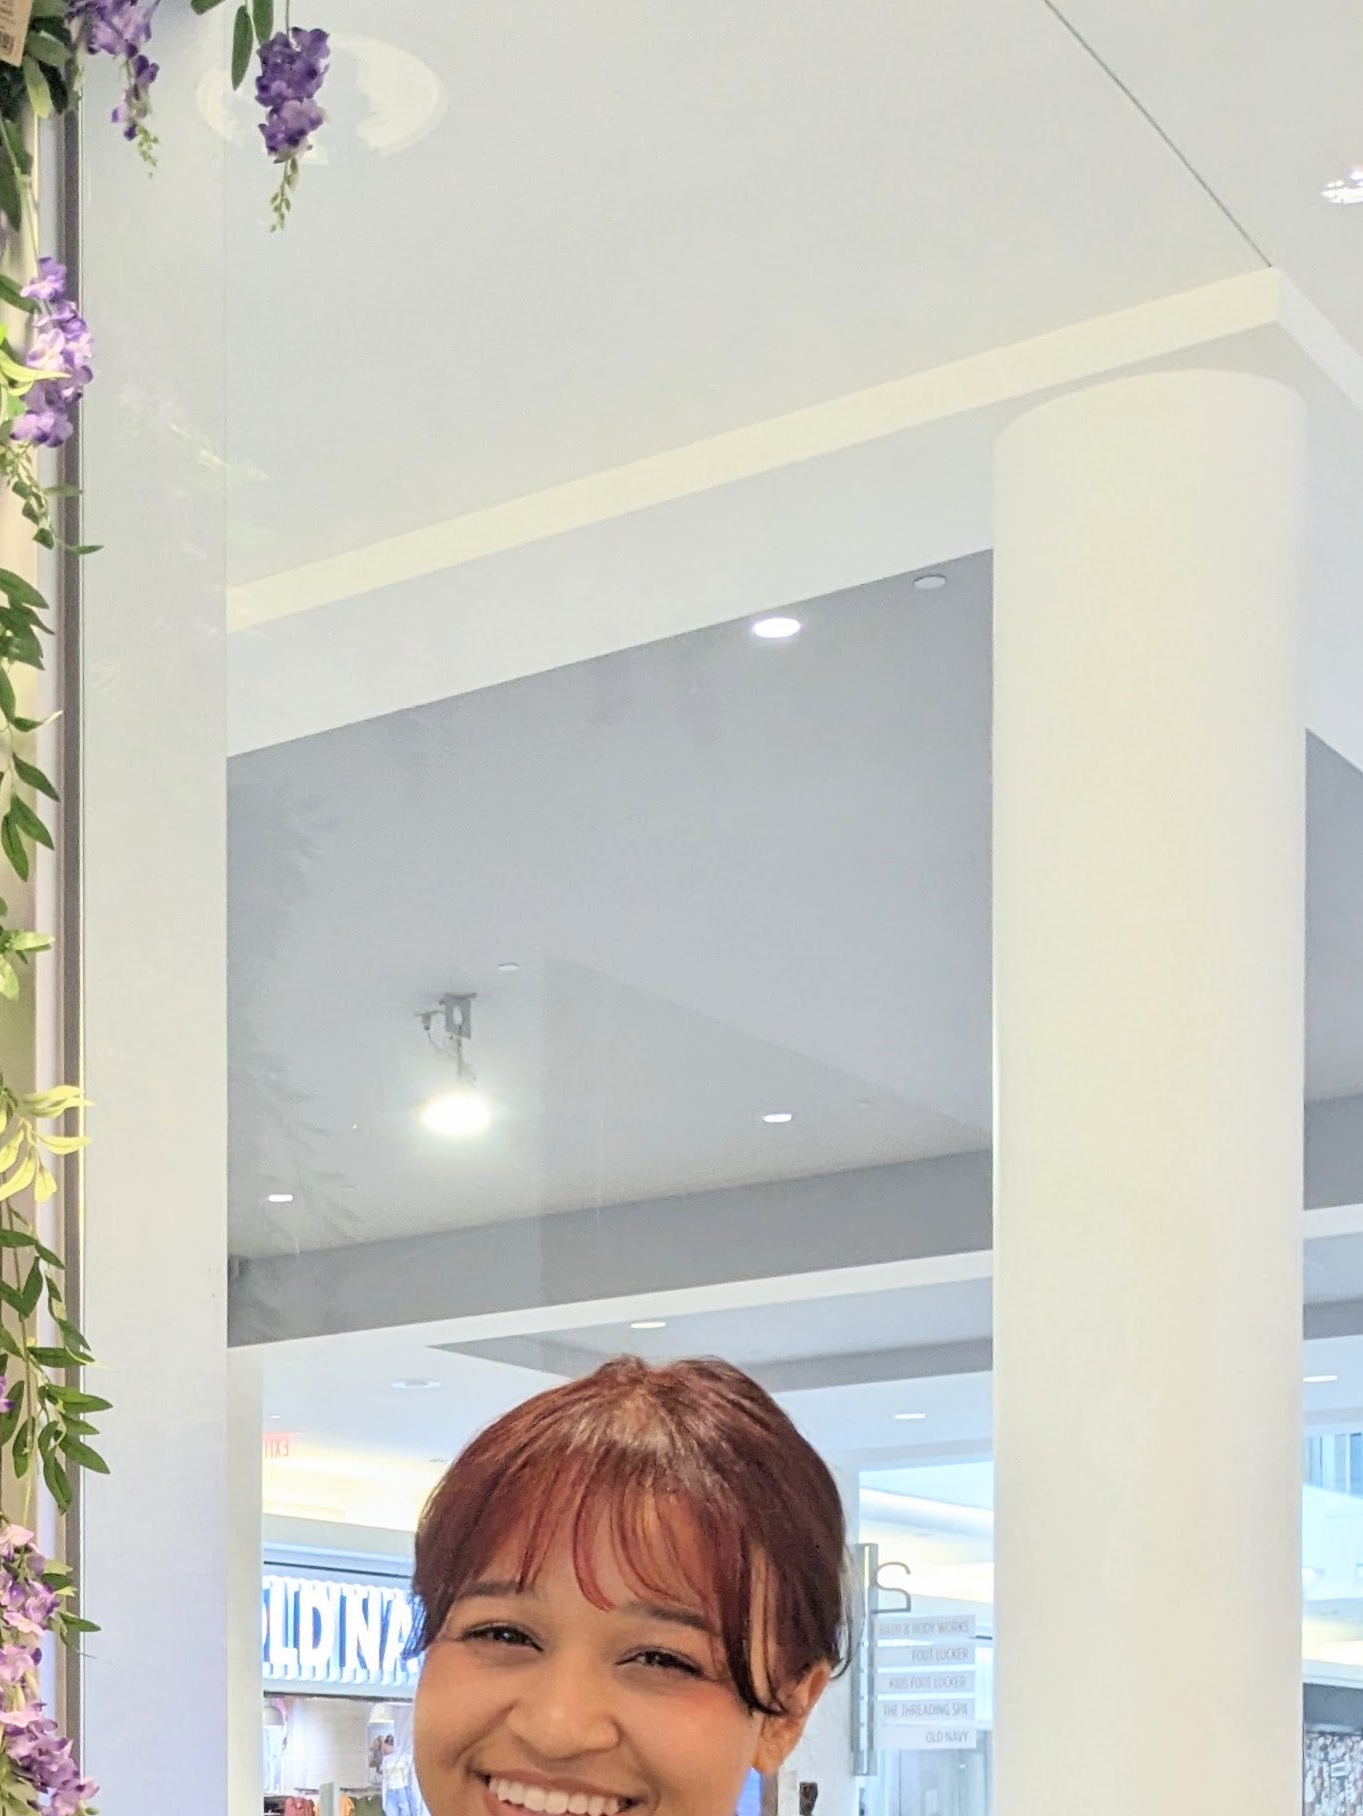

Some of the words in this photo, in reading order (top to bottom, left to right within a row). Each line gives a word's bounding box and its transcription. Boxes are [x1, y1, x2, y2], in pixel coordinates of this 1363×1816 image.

[262, 1584, 336, 1667] LD
[912, 1621, 935, 1634] BODY
[937, 1619, 970, 1632] WORKS
[912, 1648, 933, 1661] FOOT
[935, 1648, 969, 1660] LOCKER
[889, 1677, 909, 1690] KIDS
[910, 1676, 932, 1689] FOOT
[934, 1675, 967, 1688] LOCKER
[883, 1704, 898, 1717] THE
[901, 1703, 950, 1717] THREADING
[952, 1703, 968, 1716] SPA
[926, 1731, 943, 1744] OLD
[945, 1731, 969, 1743] NAVY
